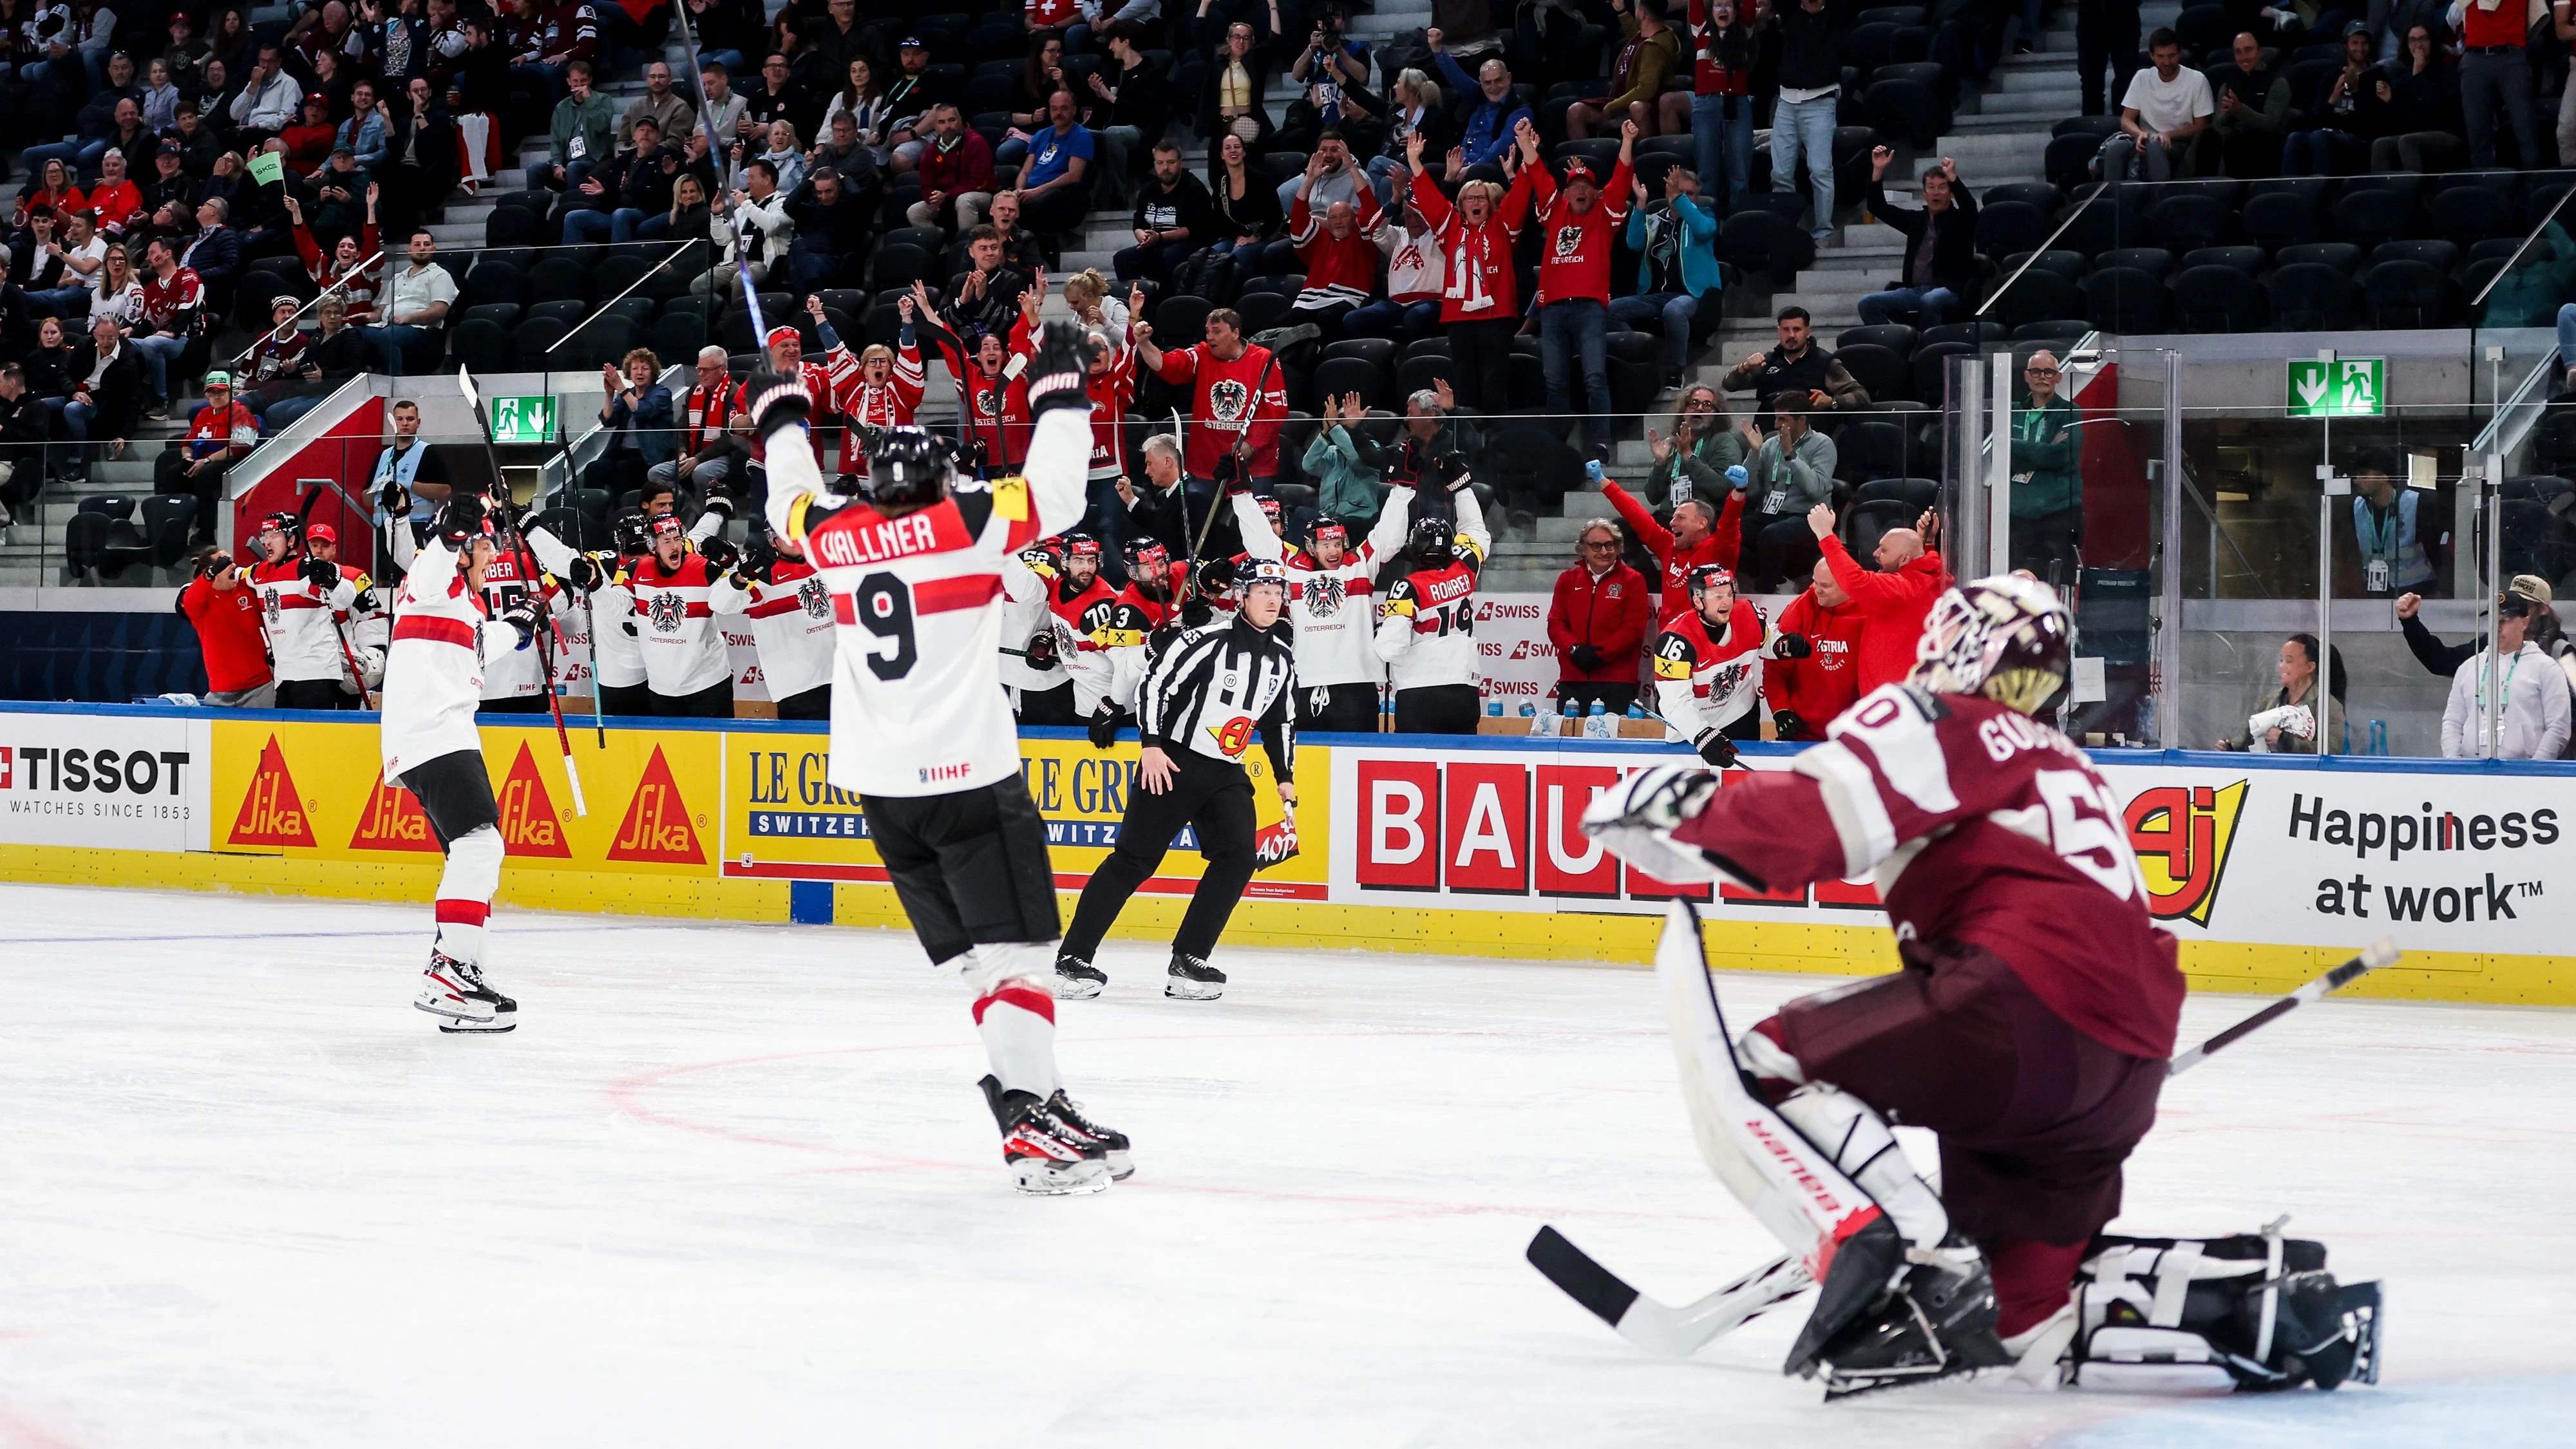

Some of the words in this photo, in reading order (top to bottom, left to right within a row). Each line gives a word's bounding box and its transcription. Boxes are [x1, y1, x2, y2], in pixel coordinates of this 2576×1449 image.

[1240, 388, 1262, 437] CCM
[820, 513, 936, 565] WALLNER
[1435, 536, 1443, 546] 19
[1023, 550, 1050, 565] 52
[1390, 580, 1410, 600] 19
[1428, 574, 1471, 602] ROHRER
[1084, 603, 1112, 630] 70
[1115, 607, 1131, 629] 3
[1494, 604, 1540, 620] SWISS
[855, 571, 918, 681] 9
[1182, 629, 1202, 645] 65
[1304, 623, 1346, 633] ÖSTERREICH
[649, 636, 687, 645] ÖSTERREICH
[1660, 635, 1687, 662] 16
[1824, 658, 1846, 671] HOCKEY
[1493, 681, 1539, 696] SWISS
[19, 747, 190, 796] TISSOT
[749, 752, 789, 804] LE
[931, 762, 972, 782] IIHF
[1021, 757, 1063, 811] LE
[10, 799, 84, 817] WATCHES
[93, 803, 143, 819] SINCE
[153, 805, 191, 821] 1853
[239, 772, 302, 837] Sika
[620, 783, 690, 852] Sika
[1370, 779, 1604, 875] BAU
[2287, 793, 2560, 862] Happiness
[1256, 833, 1298, 862] AOP
[2315, 874, 2372, 918] at
